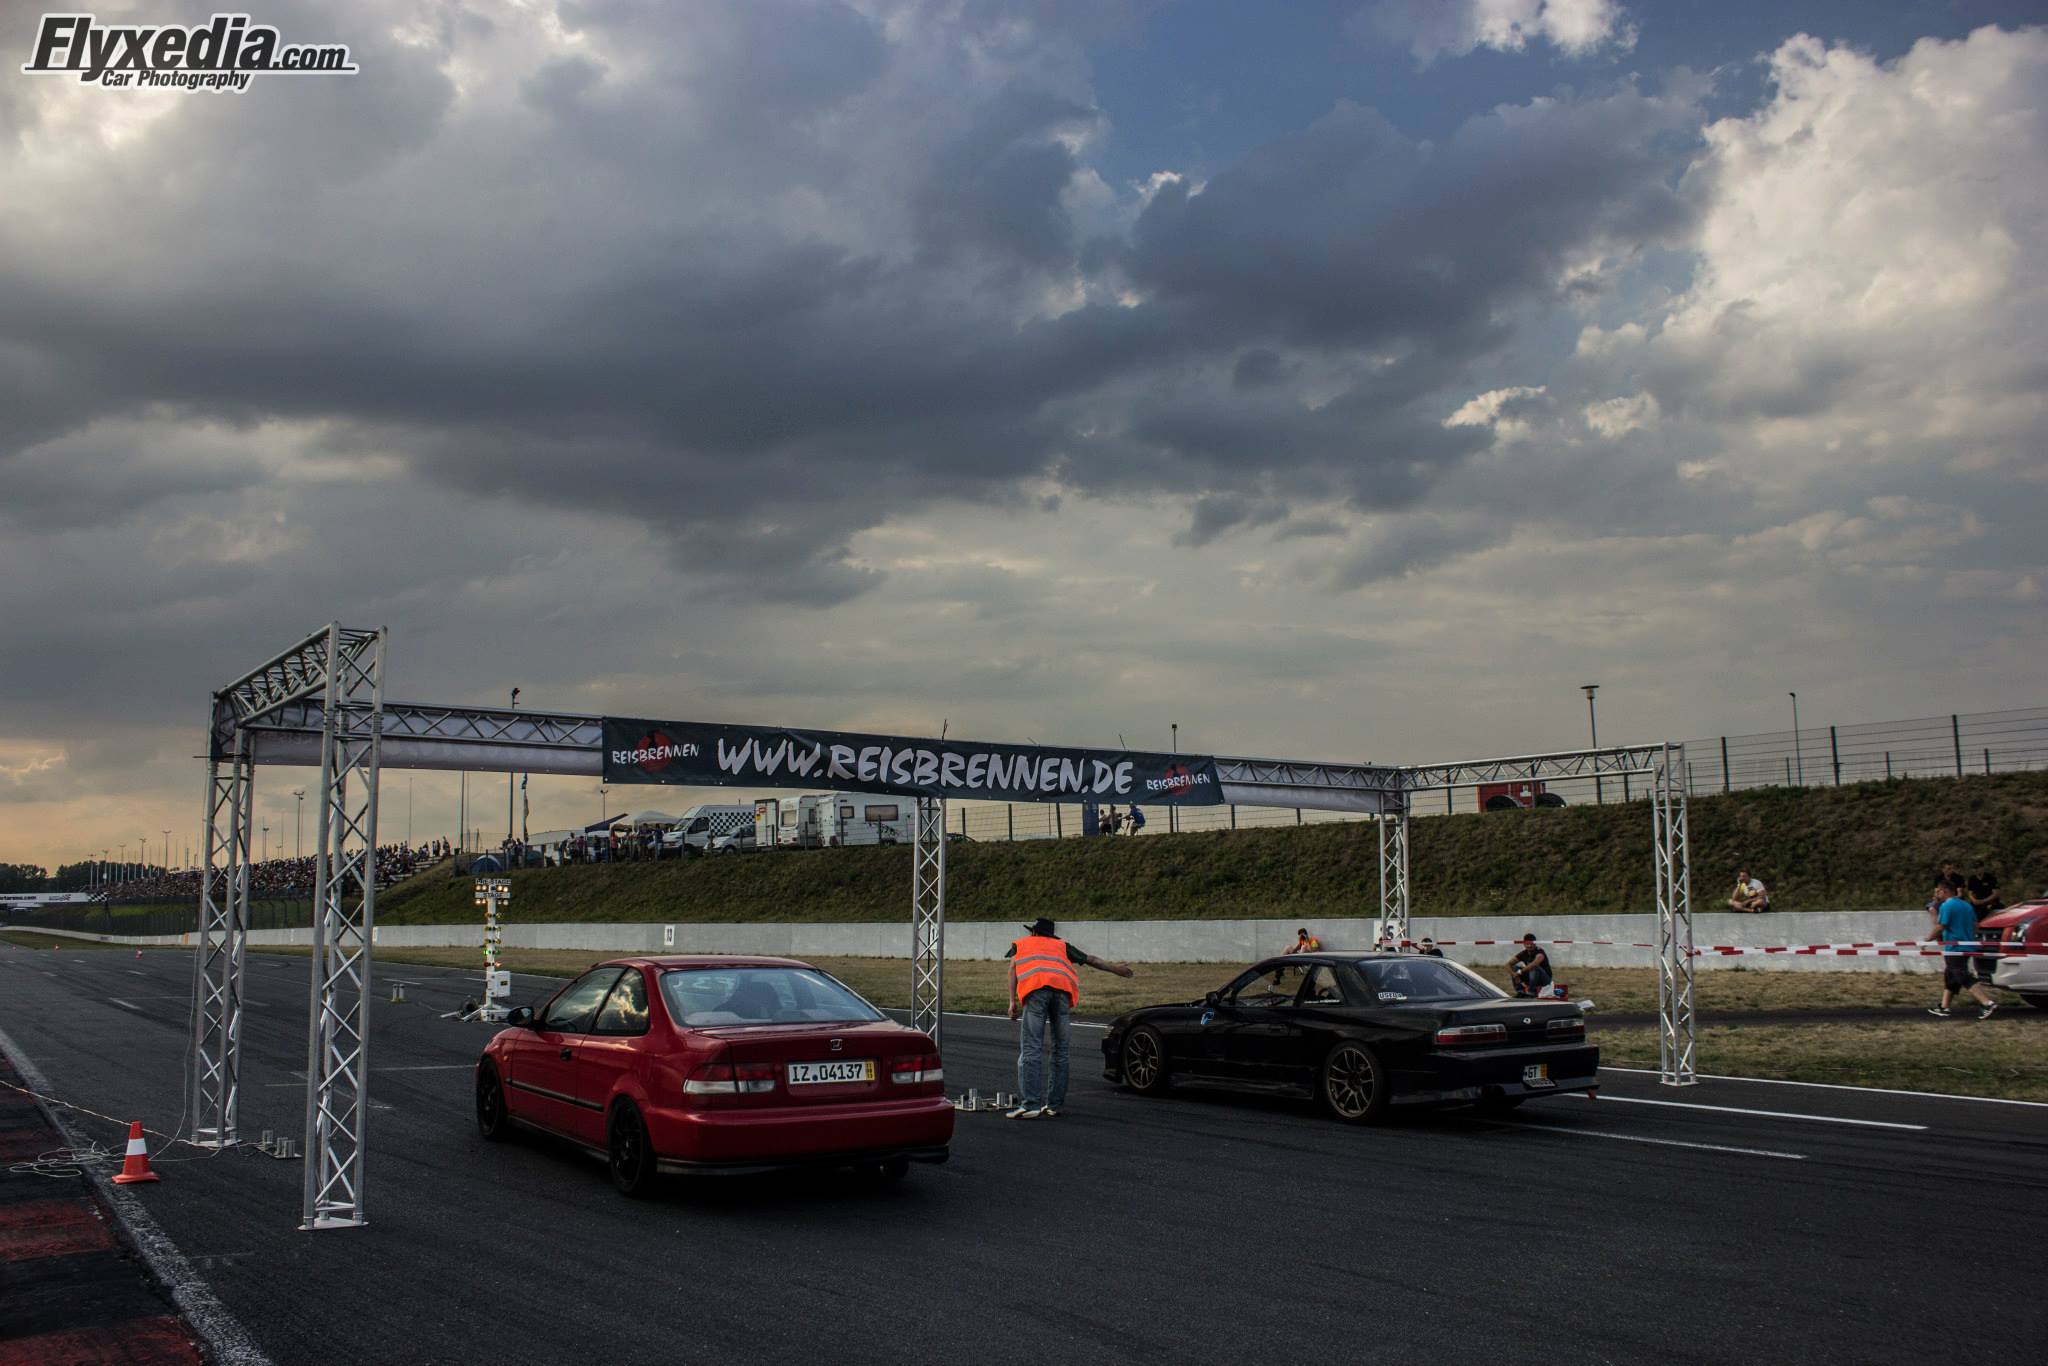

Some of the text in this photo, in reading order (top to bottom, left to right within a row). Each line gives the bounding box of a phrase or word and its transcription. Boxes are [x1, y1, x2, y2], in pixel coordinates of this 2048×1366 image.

[612, 743, 699, 764] REISBRENNEN
[717, 737, 1133, 794] WWW.REISBRENNEN.DE
[1146, 773, 1210, 791] REISBRENNEN
[793, 1066, 810, 1081] IZ
[819, 1064, 862, 1080] 04137
